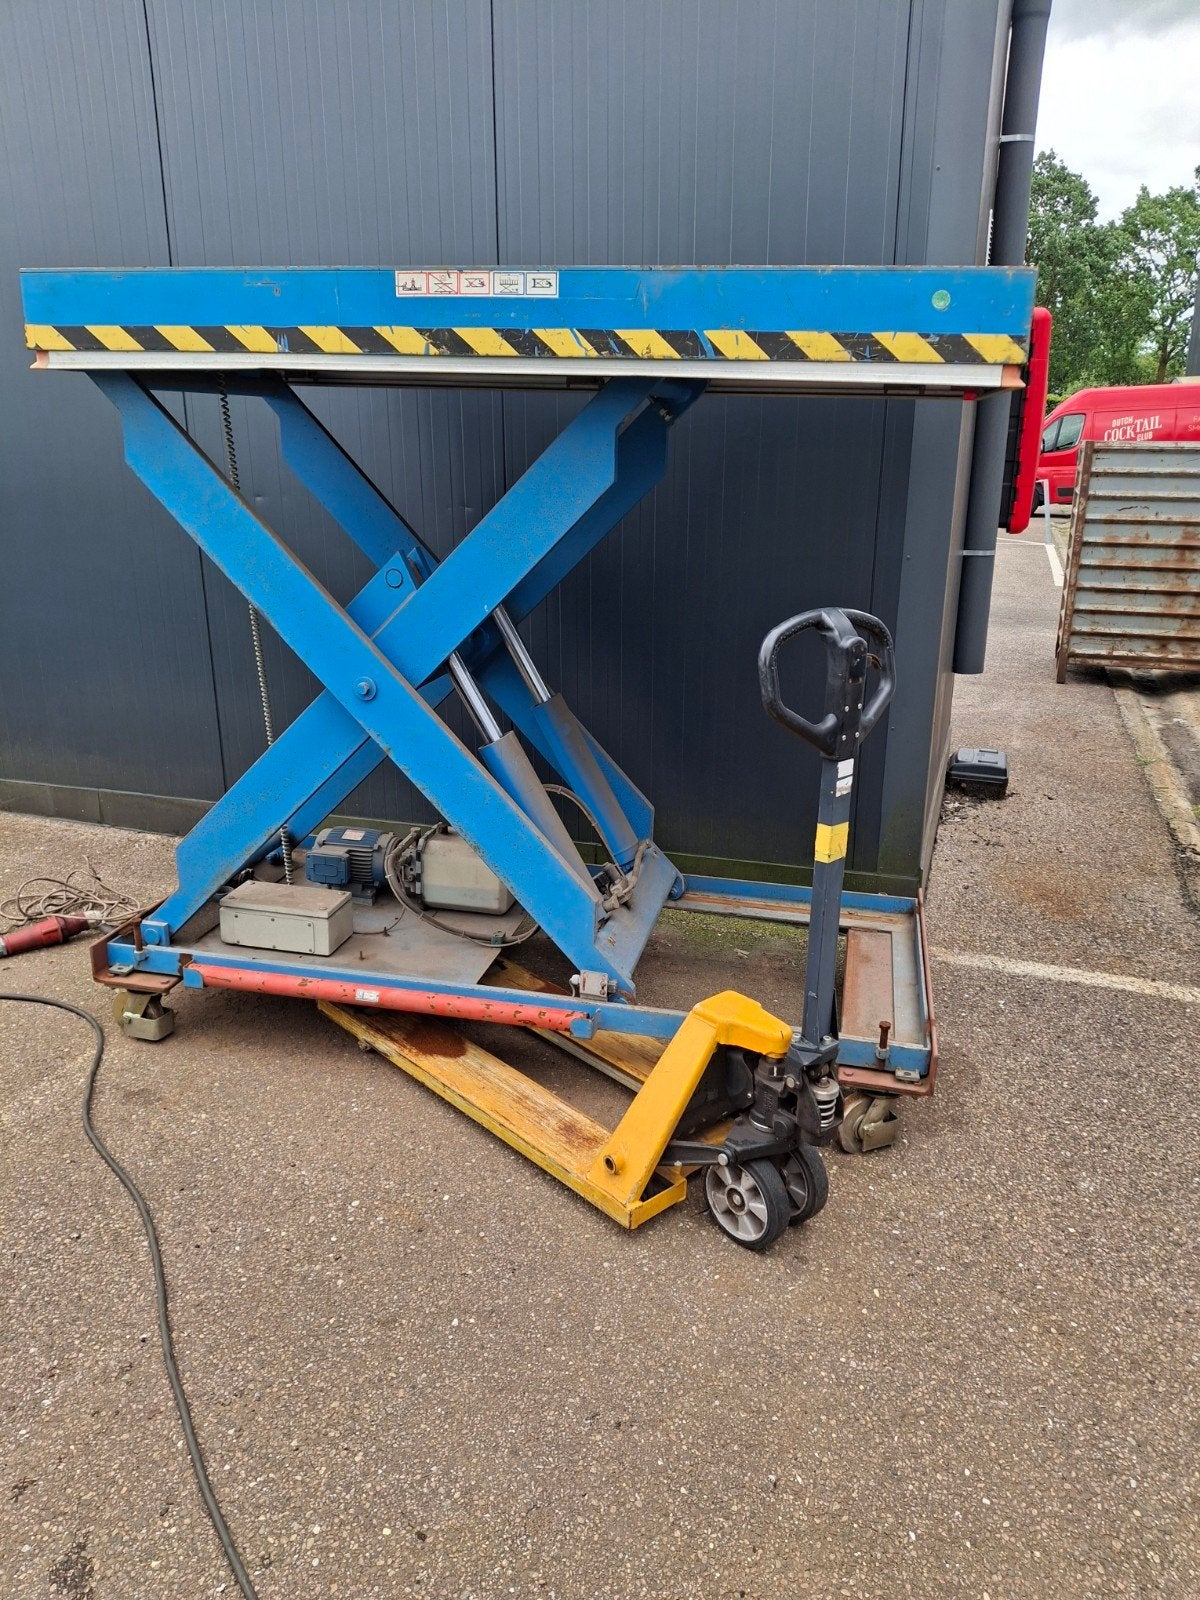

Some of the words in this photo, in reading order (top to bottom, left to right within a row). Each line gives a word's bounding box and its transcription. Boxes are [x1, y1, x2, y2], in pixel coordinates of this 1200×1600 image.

[1112, 416, 1133, 427] DUTCH
[1104, 416, 1162, 441] COCKTAIL
[1136, 431, 1153, 441] CLUB
